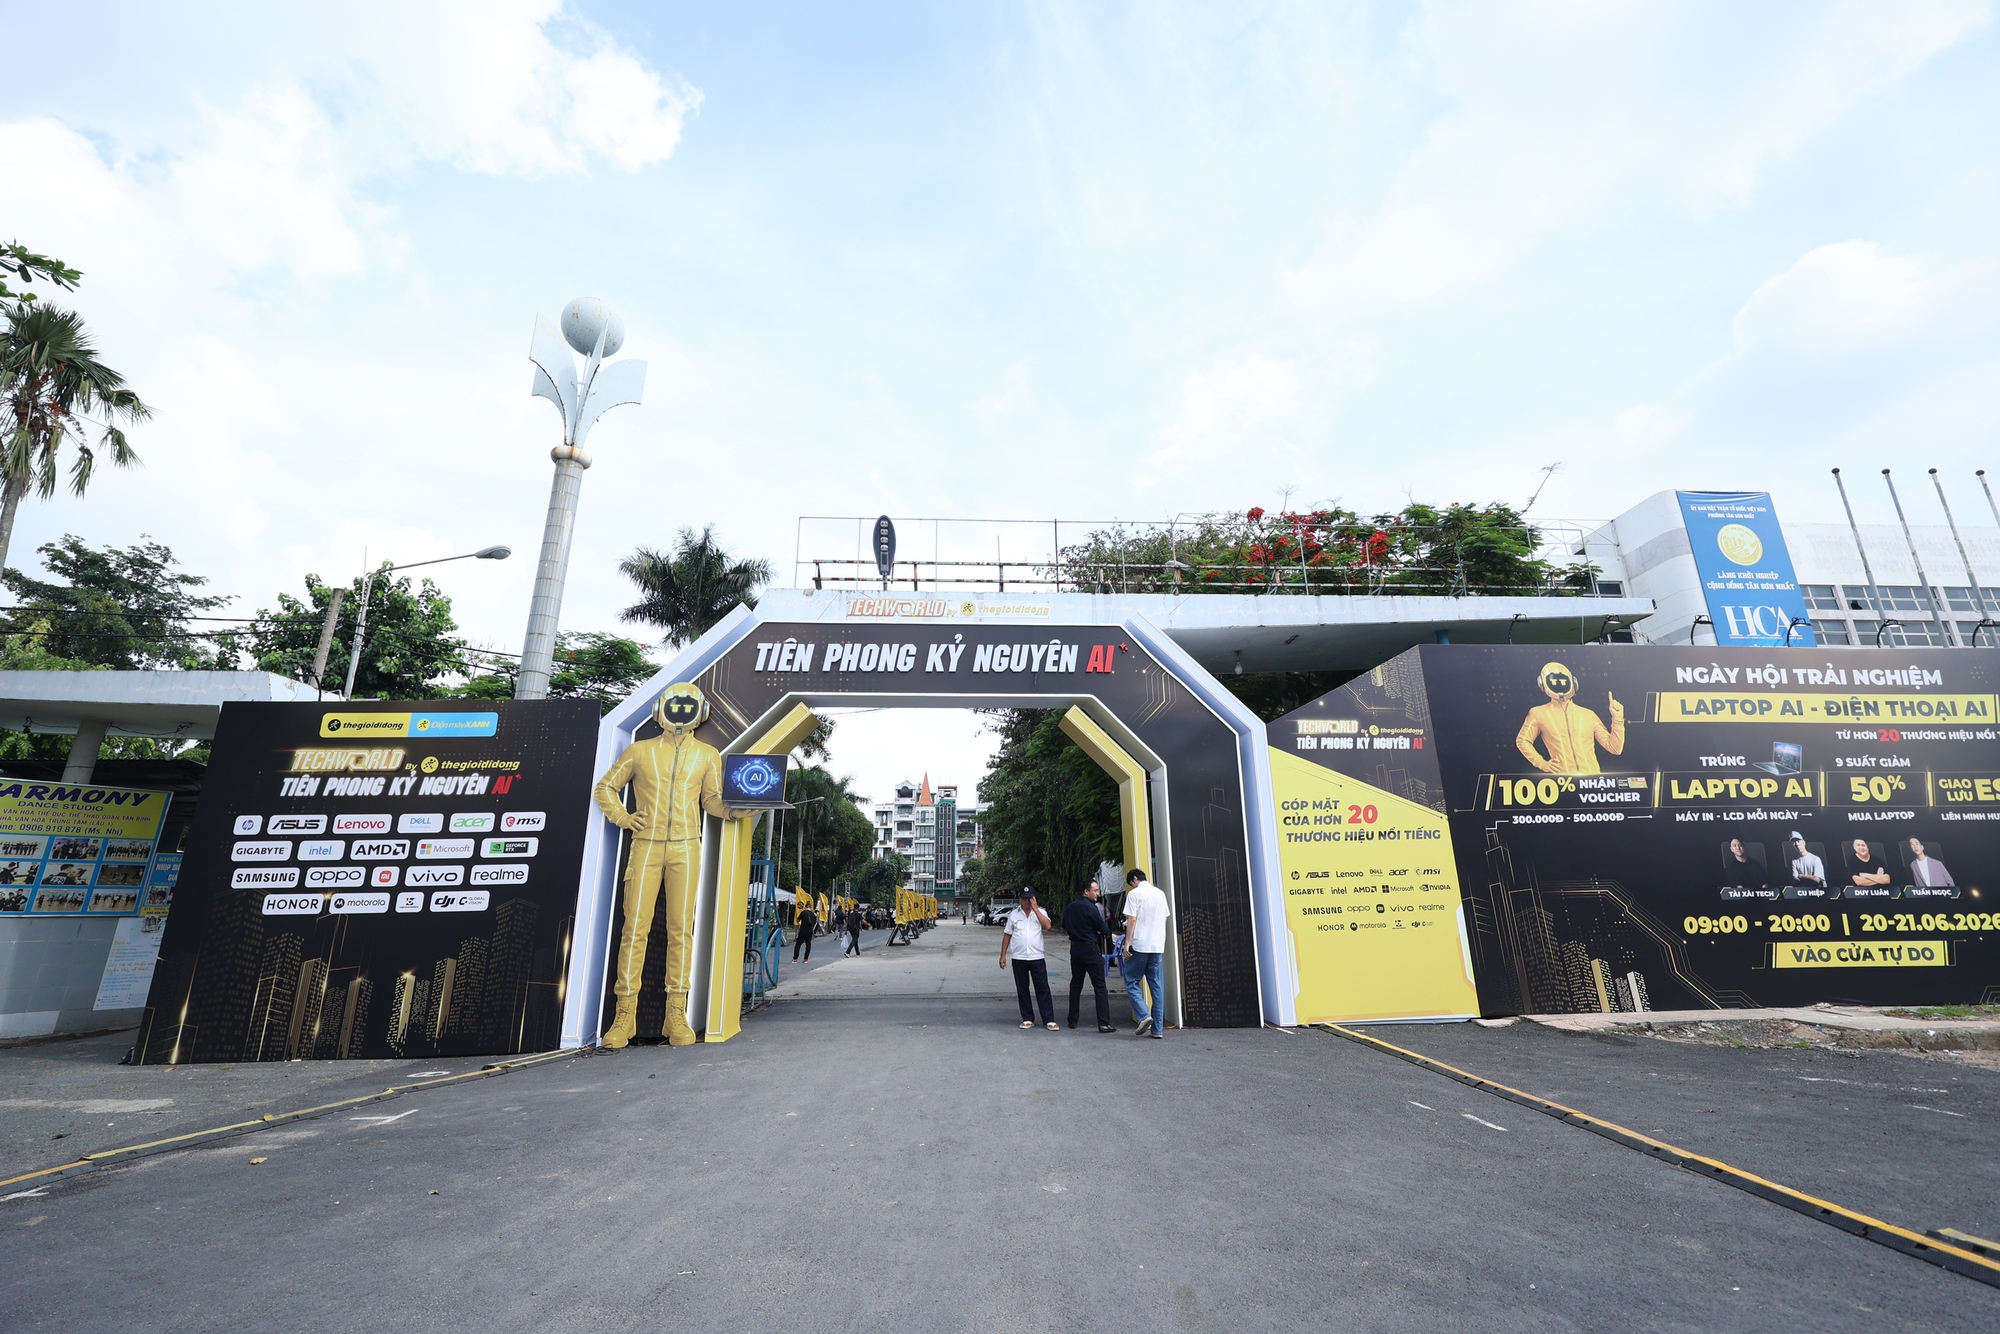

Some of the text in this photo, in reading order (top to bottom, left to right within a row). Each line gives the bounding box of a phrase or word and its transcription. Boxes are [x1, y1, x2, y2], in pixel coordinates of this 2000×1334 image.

[1717, 570, 1736, 579] LÀNG
[1755, 571, 1779, 580] NGHIỆP
[1745, 581, 1759, 589] TÂN
[1776, 581, 1794, 590] NHẤT
[846, 599, 946, 617] TECHWORLD
[978, 604, 1049, 616] thegioididong
[1720, 606, 1802, 637] HCA
[755, 634, 1115, 673] TIÊN PHONG KỶ NGUYÊN AI
[1676, 663, 1942, 690] NGÀY HỘI TRẢI NGHIỆM
[1681, 696, 1988, 721] LAPTOP AI ĐIỆN THOẠI AI
[343, 721, 404, 730] thegioididong
[1298, 720, 1358, 734] TECHWORLD
[1836, 729, 1850, 739] TỪ
[1854, 731, 1877, 739] HƠN
[1878, 728, 1900, 742] 20
[1901, 730, 1946, 740] THƯƠNG
[1949, 730, 1973, 742] HIỆU
[1976, 728, 1996, 740] NỔI
[1297, 734, 1423, 749] TIÊN PHONG KỶ NGUYÊN AI
[292, 750, 520, 772] TECHWORLD By thegioididong
[1700, 754, 1746, 767] TRÚNG
[1835, 755, 1910, 767] 9 SUẤT GIẢM
[750, 773, 762, 781] AI
[280, 771, 513, 796] TIÊN PHONG KỶ NGUYÊN AI
[1579, 777, 1616, 790] NHẬN
[1670, 778, 1812, 799] LAPTOP AI
[1850, 775, 1906, 802] 50%
[1939, 779, 1972, 789] GIAO
[0, 782, 150, 806] ARMONY
[1498, 777, 1576, 806] 100%
[1579, 792, 1640, 803] VOUCHER
[1946, 789, 1973, 801] LƯU
[1281, 798, 1340, 812] GÓP MẶT
[1283, 804, 1378, 825] CỦA HƠN 20
[1512, 813, 1624, 824] 300.000Đ 500.000Đ
[1676, 809, 1799, 822] MÁY IN LCD MỖI NGÀY
[1848, 811, 1915, 821] MUA LAPTOP
[1941, 811, 1961, 820] LIÊN
[272, 820, 320, 830] ASUS
[337, 819, 385, 829] Lenovo
[454, 818, 491, 827] acer
[20, 824, 123, 836] 0906.919.878 (Ms. Nhi)
[1287, 826, 1441, 843] THƯƠNG HIỆU NỔI TIẾNG
[309, 846, 331, 855] intel
[355, 845, 392, 855] AMD
[236, 873, 296, 882] SAMSUNG
[412, 870, 458, 882] vivo
[474, 869, 524, 881] realme
[1809, 889, 1825, 898] HIỆP
[1912, 888, 1931, 896] TUẤN
[266, 899, 318, 910] HONOR
[1302, 906, 1342, 915] SAMSUNG
[1683, 913, 2000, 934] 09:00 20:00 20-21.06.2026
[1791, 944, 1934, 965] VÀO CỬA TỰ DO
